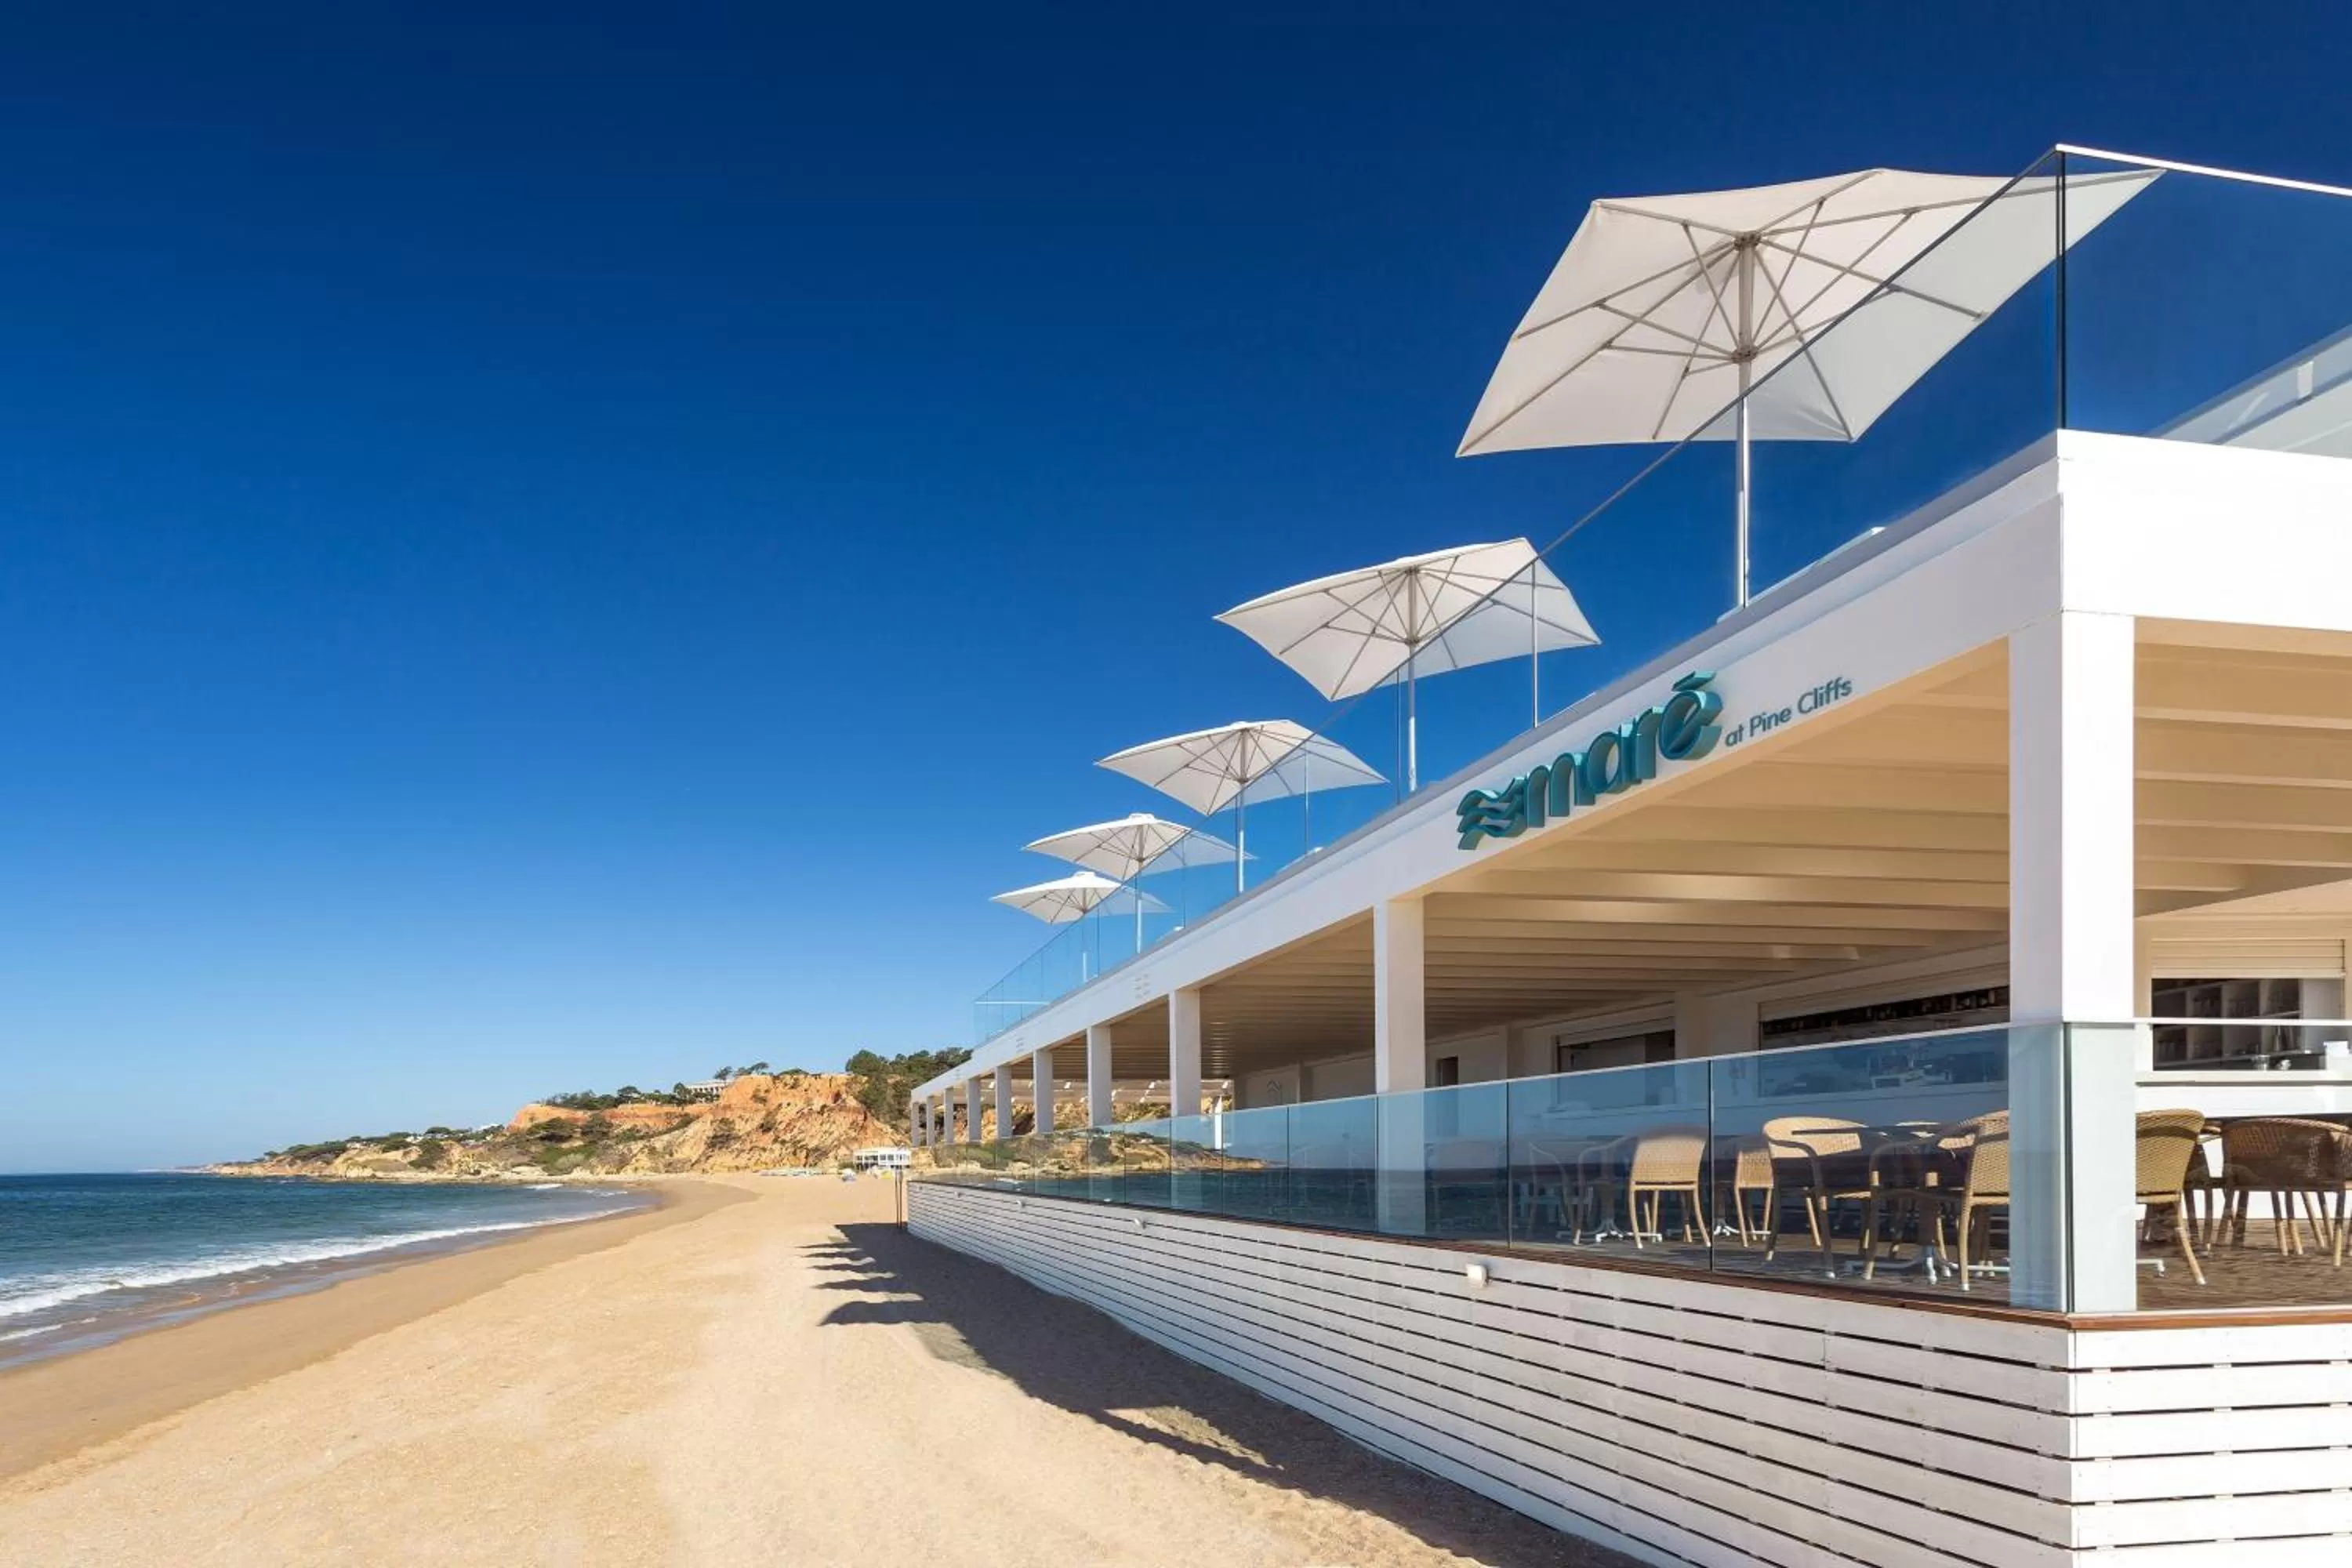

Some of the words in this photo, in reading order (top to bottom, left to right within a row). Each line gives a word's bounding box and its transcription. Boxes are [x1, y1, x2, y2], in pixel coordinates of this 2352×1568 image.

[1525, 670, 1722, 828] maré
[1725, 724, 1744, 747] at
[1749, 707, 1791, 737] Pine
[1797, 677, 1853, 713] Cliffs
